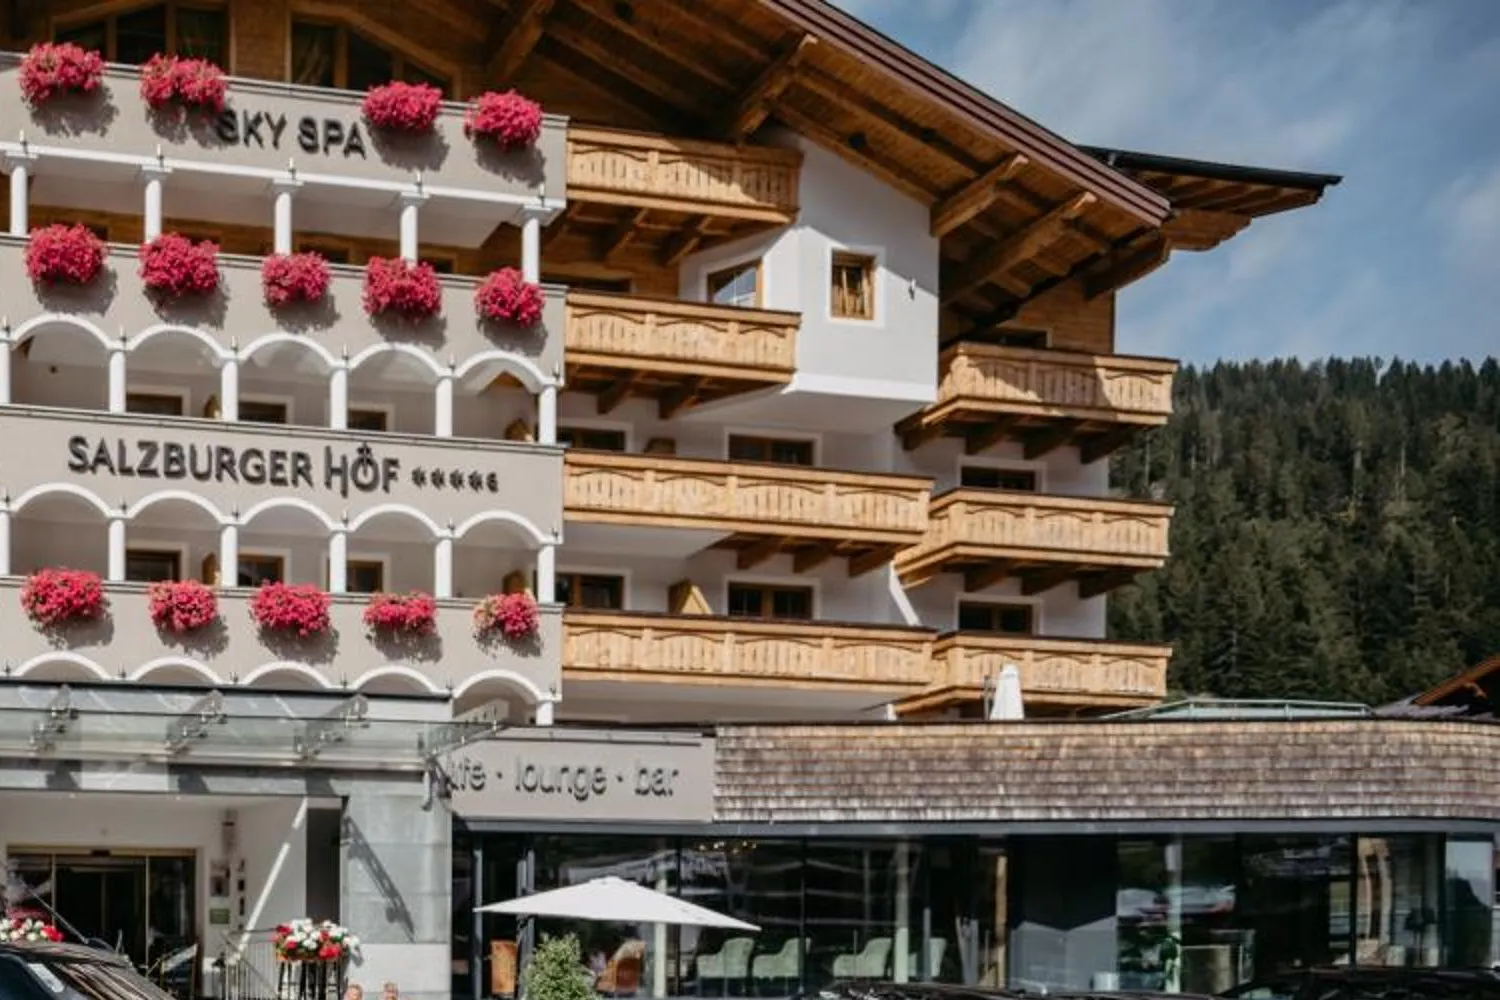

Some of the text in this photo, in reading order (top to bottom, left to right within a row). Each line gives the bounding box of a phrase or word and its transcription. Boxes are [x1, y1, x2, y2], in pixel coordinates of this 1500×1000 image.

[216, 108, 367, 160] SKY SPA
[68, 435, 313, 490] SALZBURGER
[515, 754, 607, 801] lounge
[633, 757, 679, 797] bar
